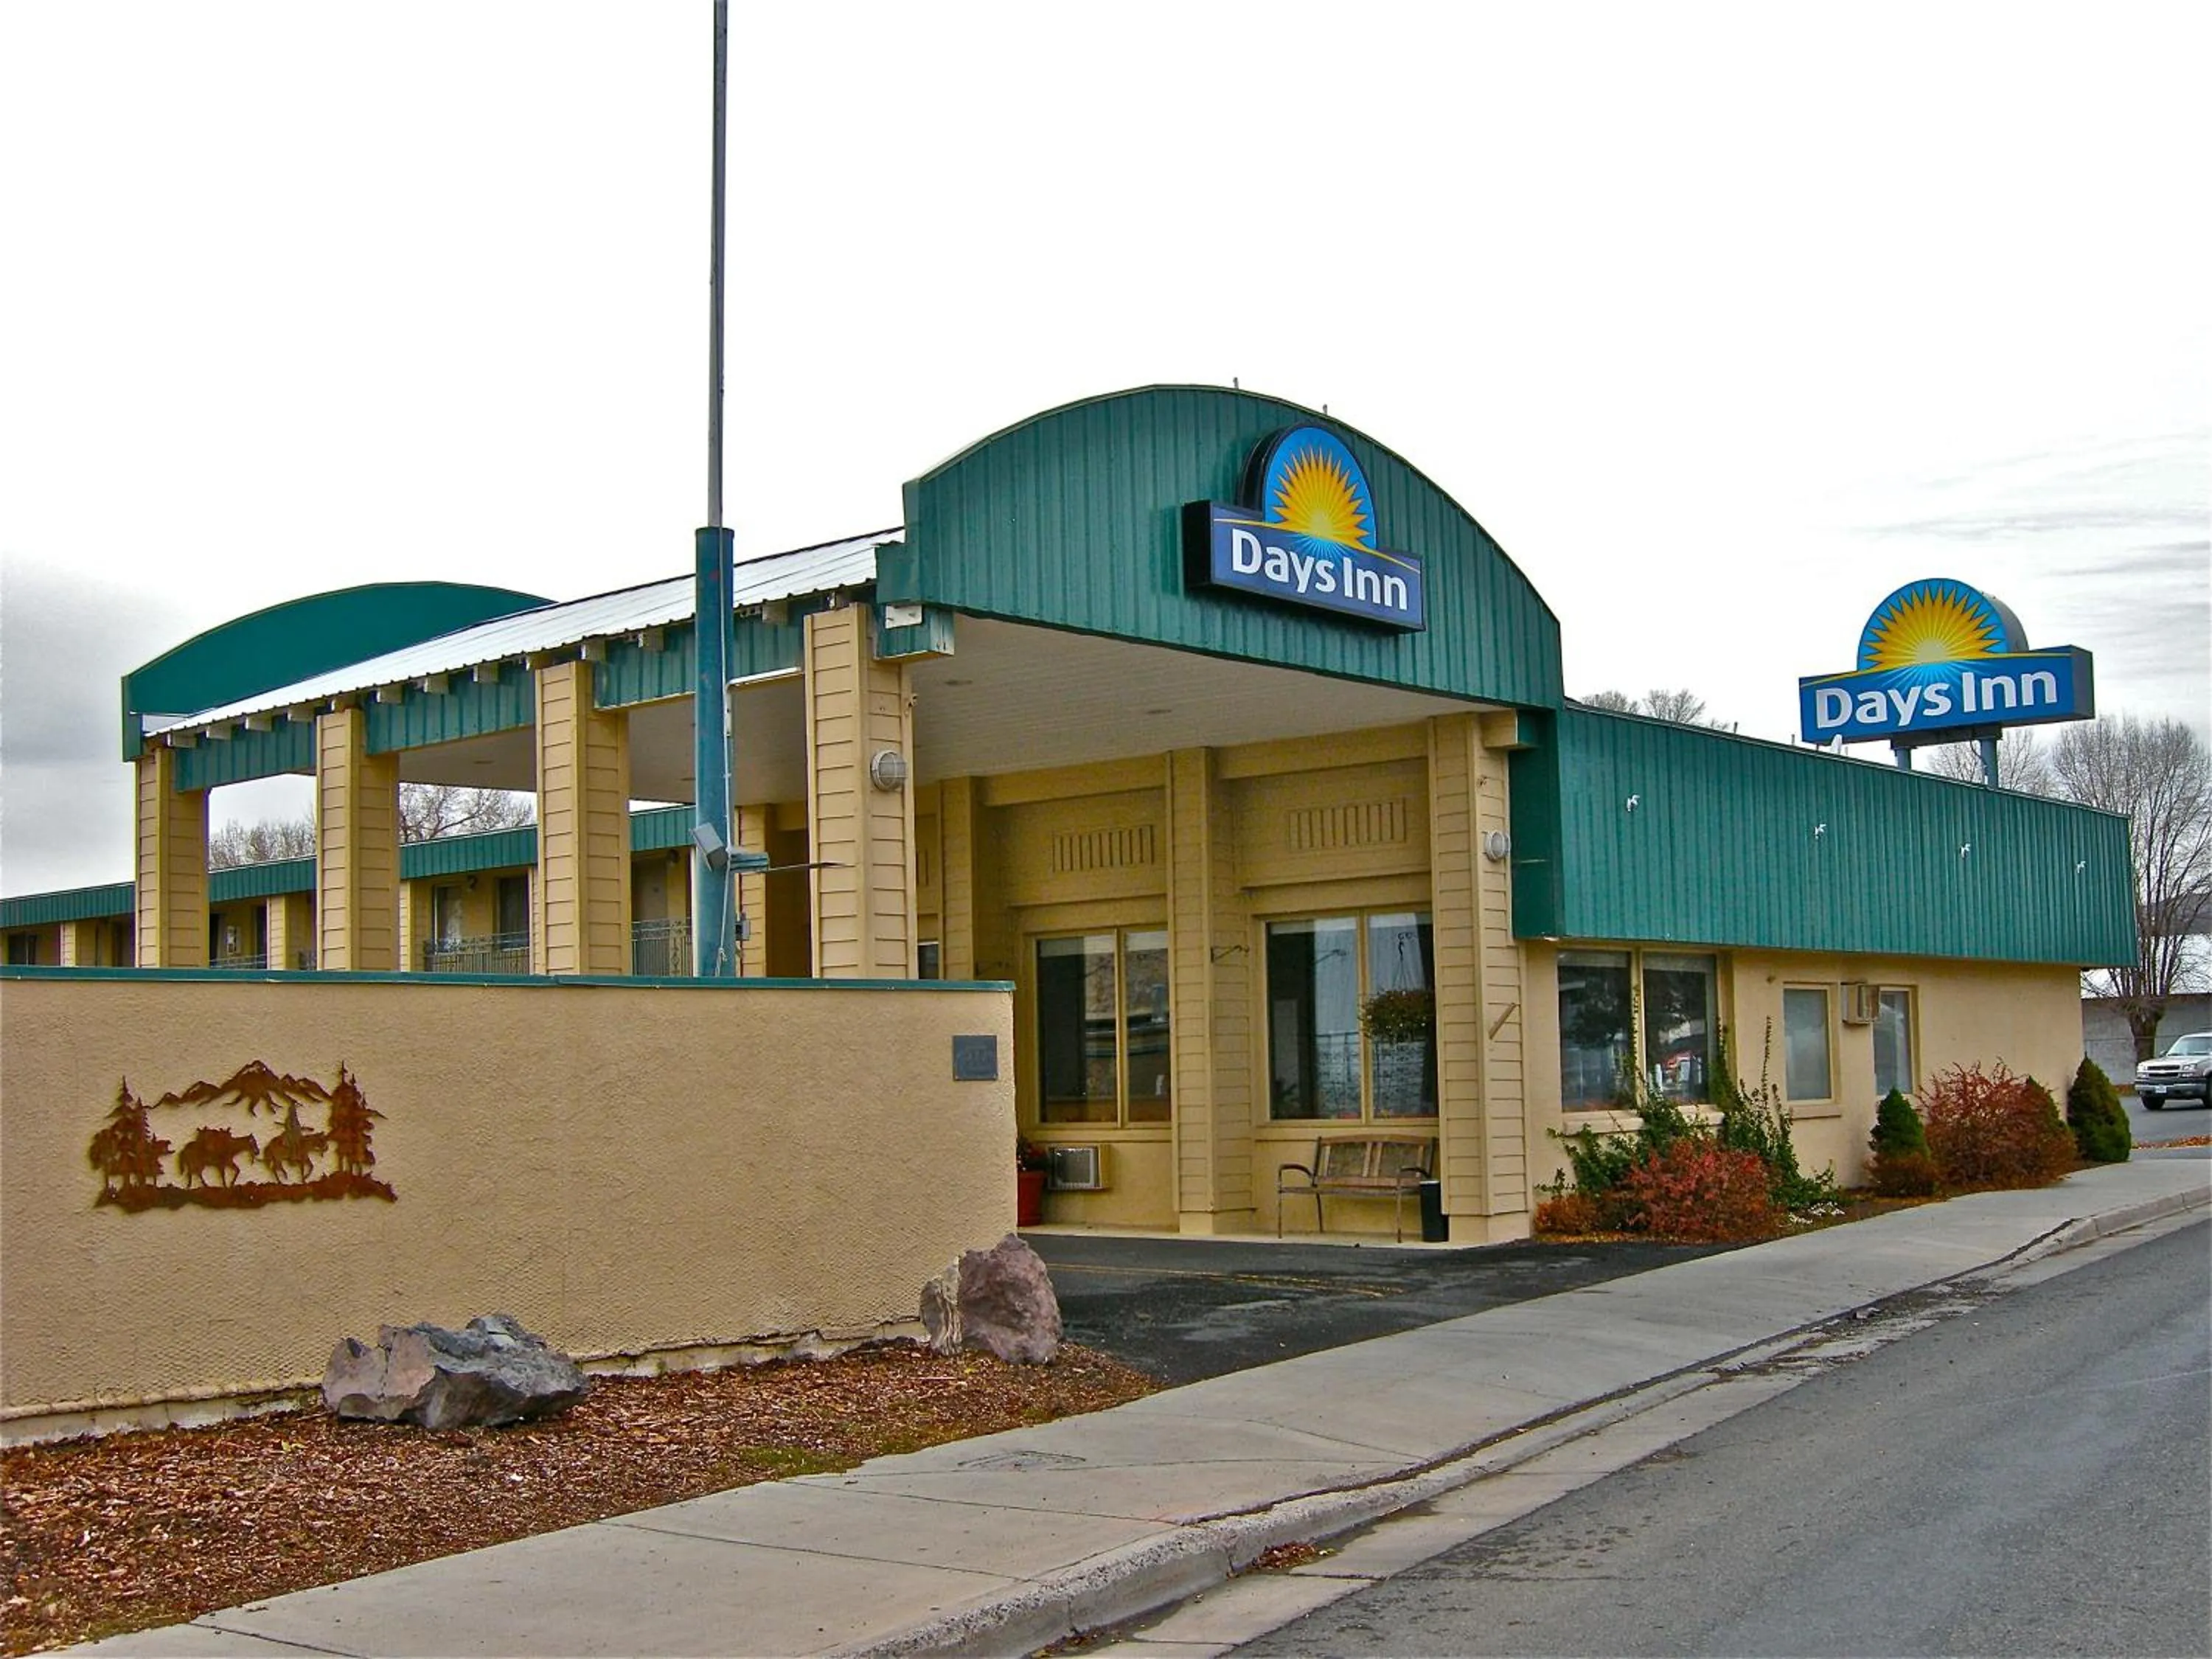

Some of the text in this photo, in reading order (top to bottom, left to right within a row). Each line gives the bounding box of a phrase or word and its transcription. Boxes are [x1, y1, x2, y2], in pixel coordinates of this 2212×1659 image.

[1231, 528, 1408, 611] Days Inn
[1815, 670, 2057, 728] Days Inn
